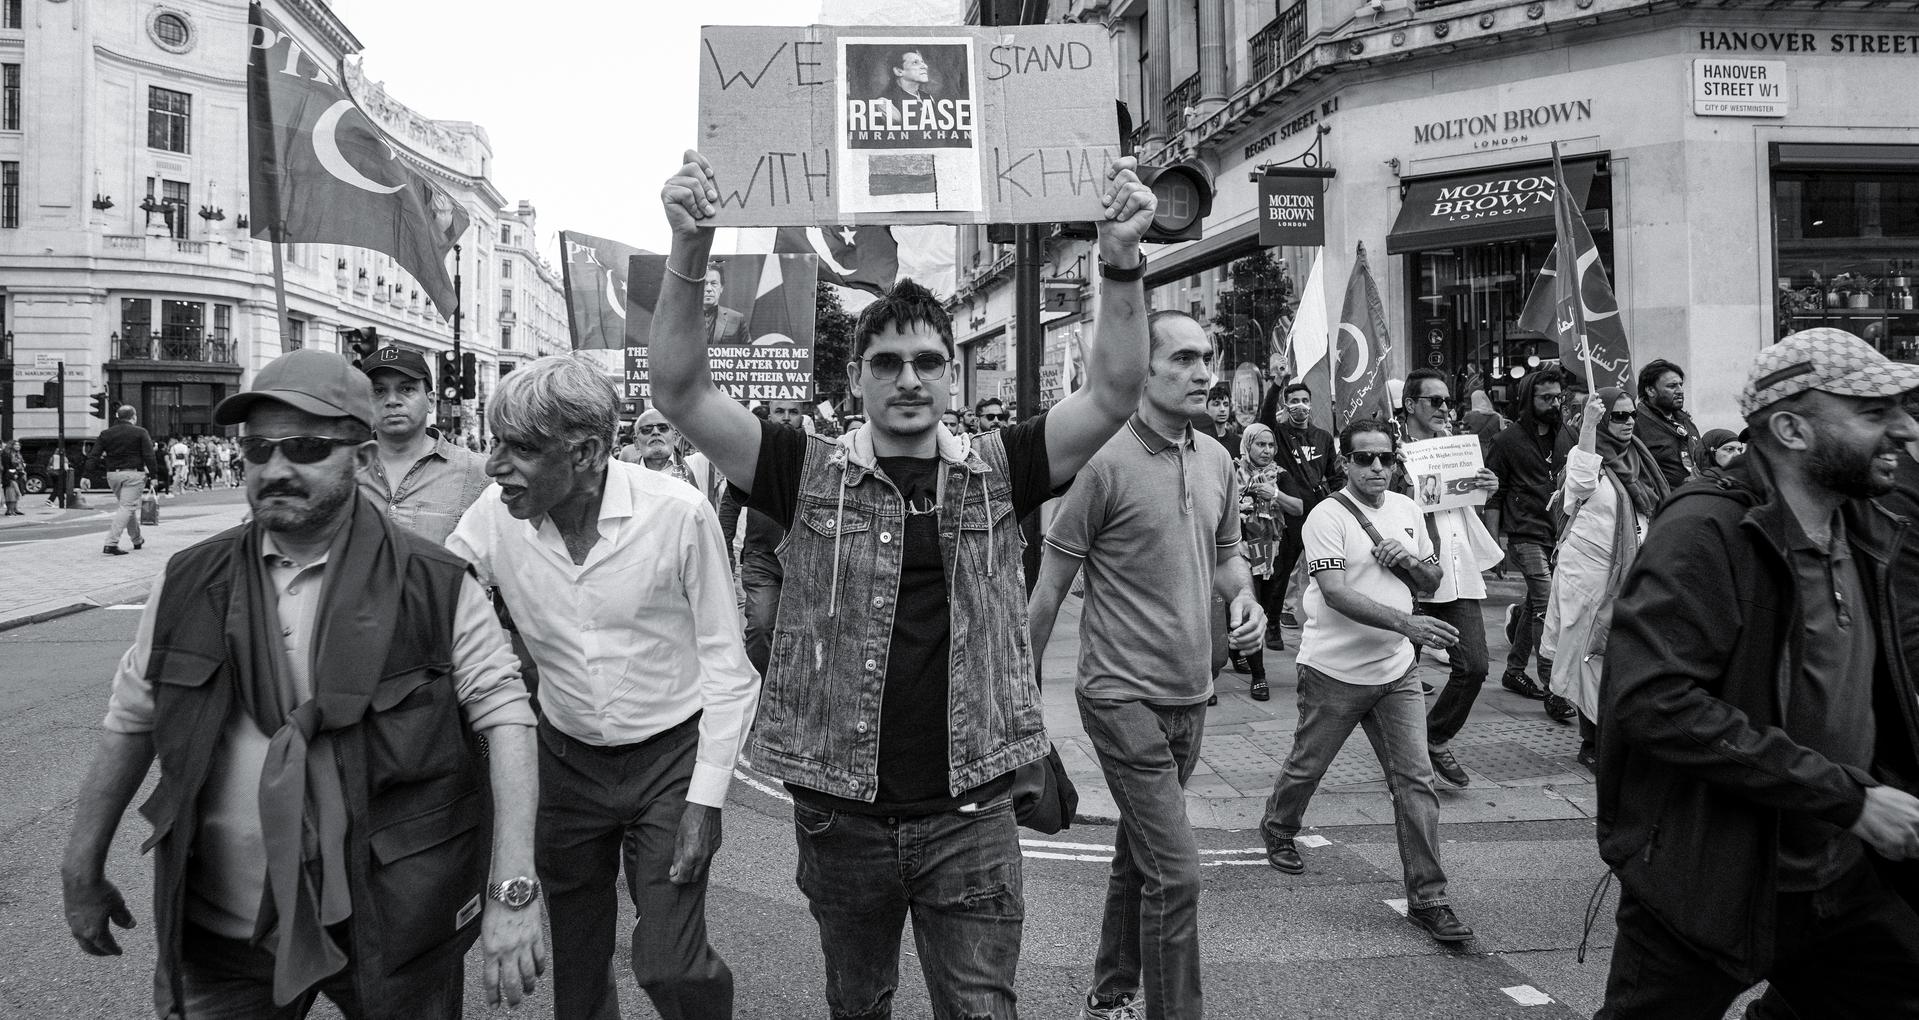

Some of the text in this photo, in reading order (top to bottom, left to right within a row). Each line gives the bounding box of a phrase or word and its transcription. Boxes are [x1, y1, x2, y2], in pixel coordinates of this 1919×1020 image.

[1700, 31, 1817, 51] HANOVER
[704, 38, 1092, 90] WE STAND
[1703, 64, 1767, 80] HANOVER
[1704, 81, 1779, 98] STREET W1
[849, 99, 972, 131] RELEASE
[1704, 104, 1774, 113] CITY OF WESTMINSTER
[1414, 98, 1592, 144] MOLTON BROWN
[847, 130, 972, 140] IMRAN KHAN
[1473, 134, 1529, 149] LONDON
[1244, 131, 1277, 160] REGENT
[711, 148, 830, 209] WITH
[1437, 175, 1556, 202] MOLTON
[1269, 194, 1315, 208] MOLTON
[1431, 189, 1556, 216] BROWN
[1269, 207, 1315, 221] BROWN
[1450, 207, 1527, 221] LONDON
[707, 347, 751, 358] COMING
[752, 347, 790, 358] AFTER
[792, 348, 809, 358] ME
[735, 359, 773, 370] AFTER
[775, 359, 800, 370] YOU
[626, 370, 631, 380] I
[735, 371, 749, 382] IN
[750, 372, 784, 382] THEIR
[785, 372, 812, 383] WAY
[748, 385, 808, 399] KHAN
